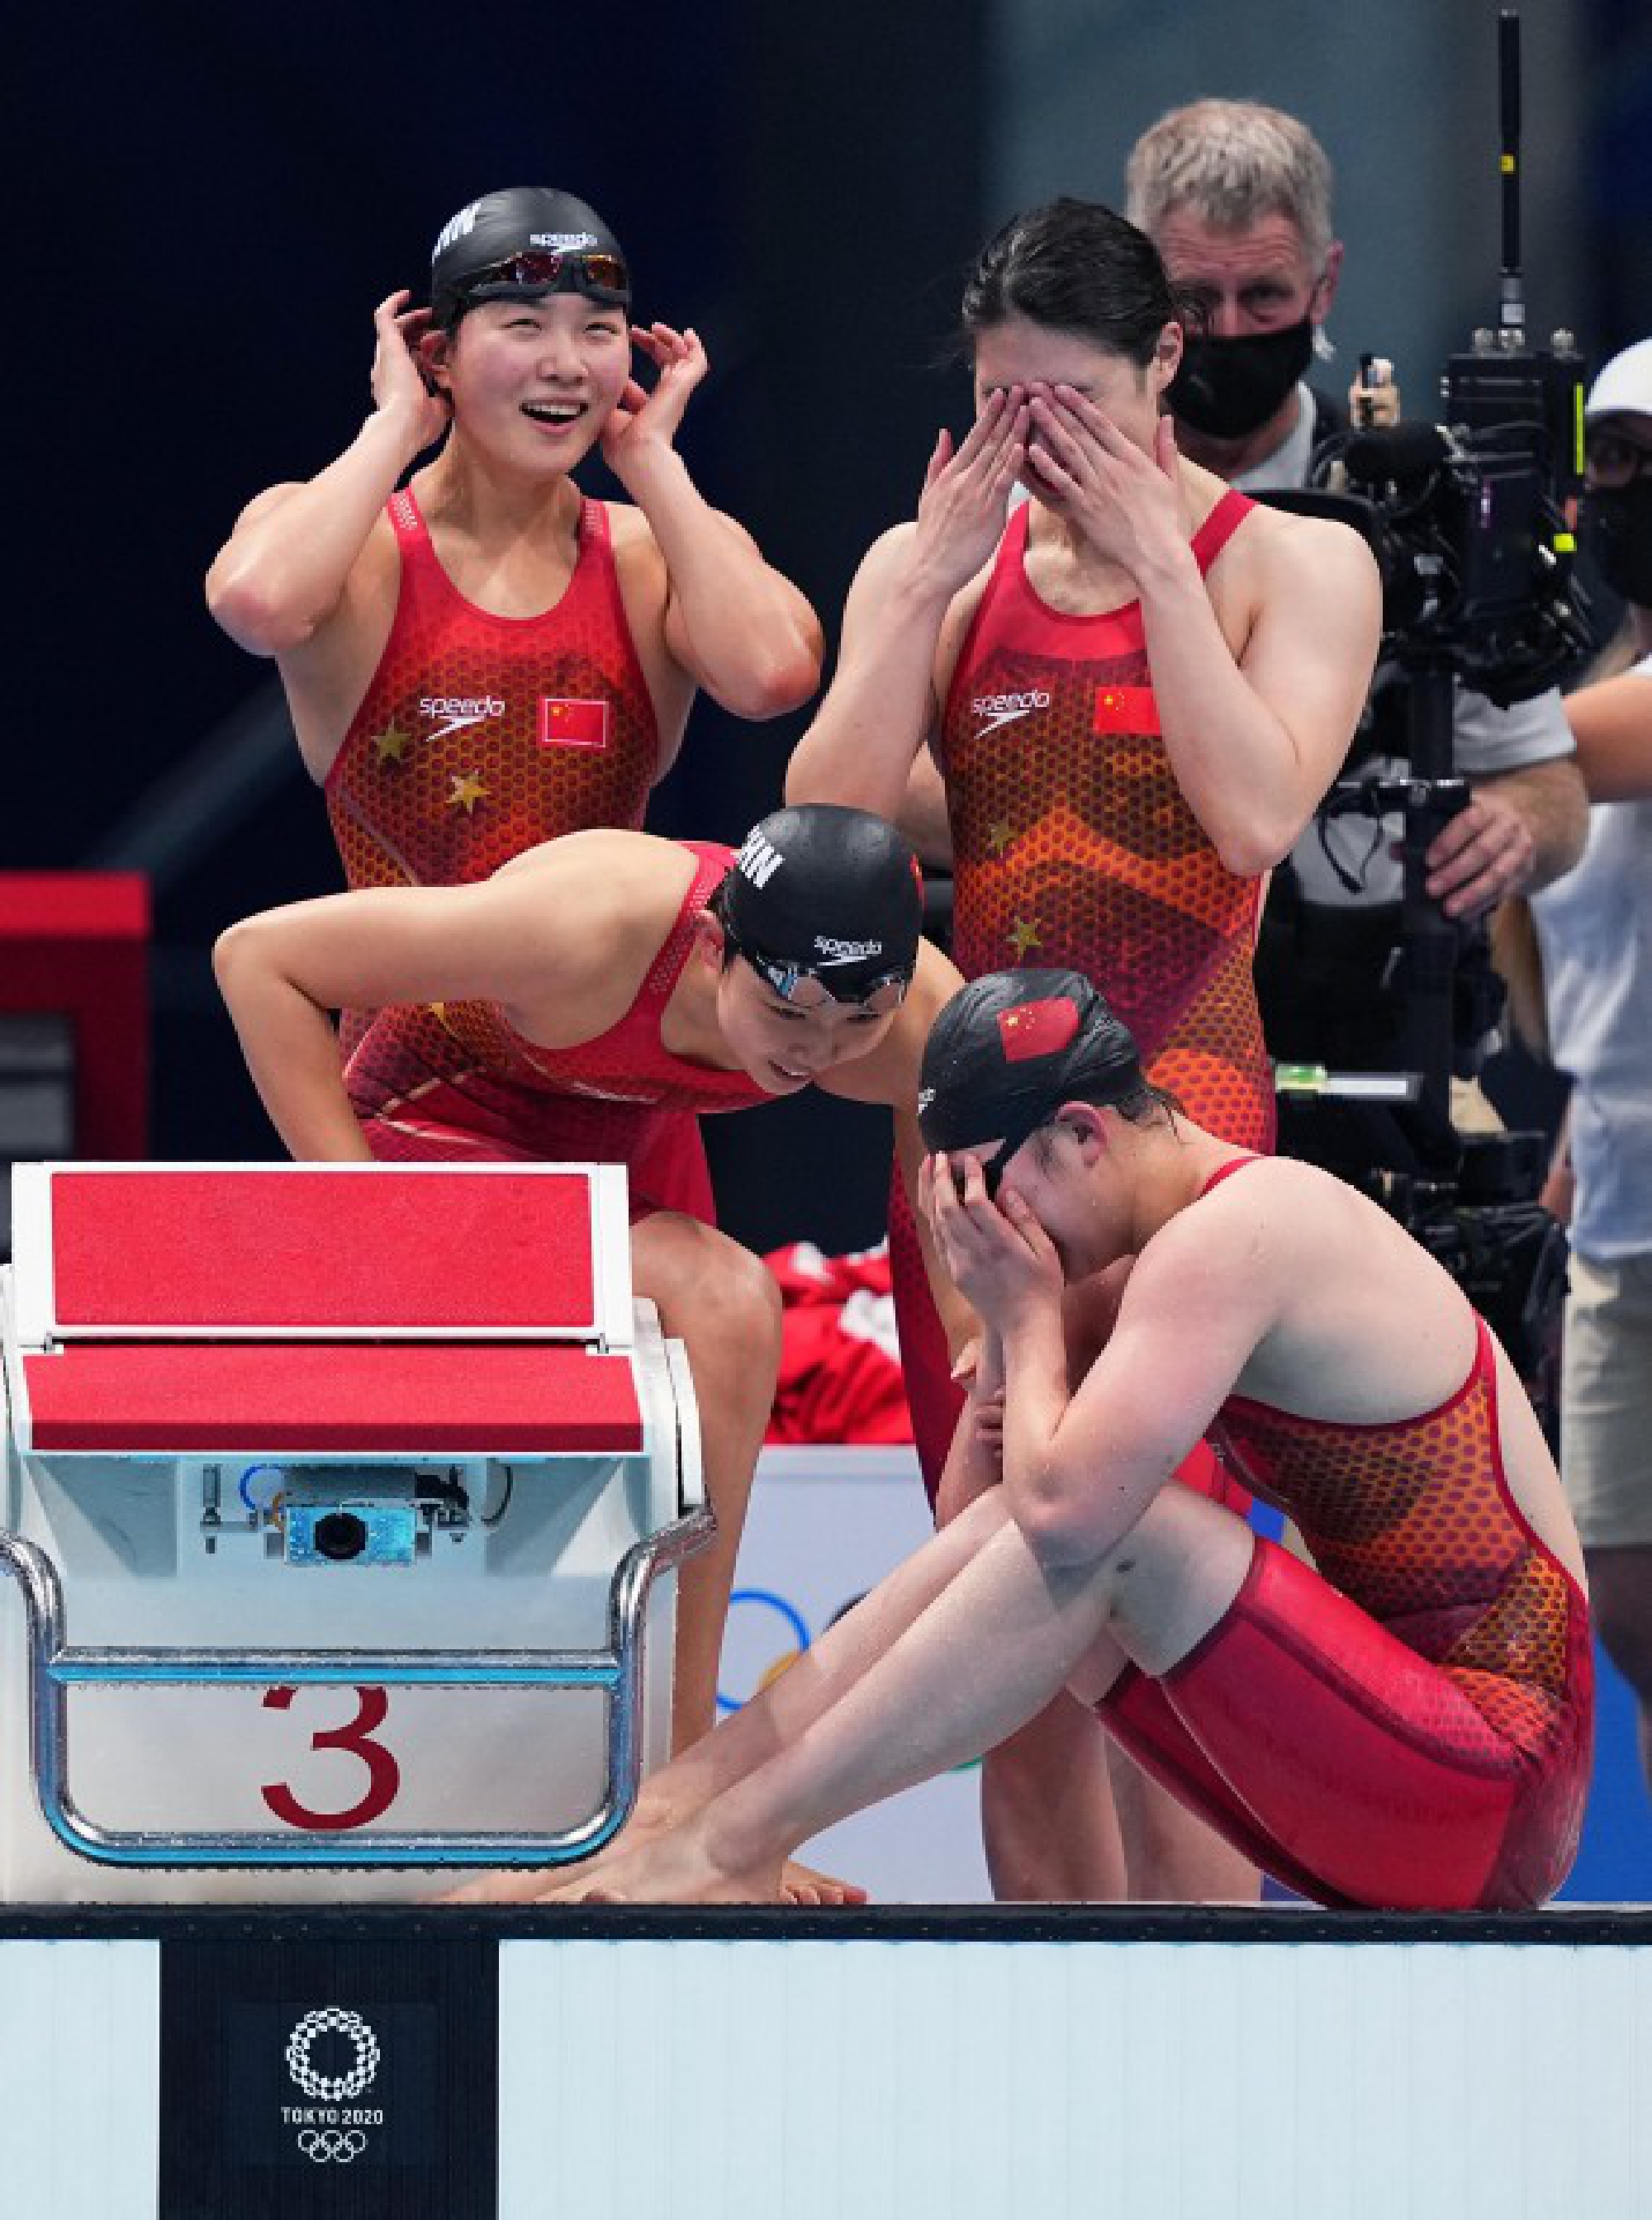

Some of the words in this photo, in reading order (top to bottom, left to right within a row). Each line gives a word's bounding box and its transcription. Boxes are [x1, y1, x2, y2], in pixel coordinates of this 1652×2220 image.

[529, 231, 598, 248] speedo
[420, 695, 505, 719] speedo
[971, 690, 1050, 716] speedo
[814, 935, 882, 955] speedo
[261, 1686, 401, 1832] 3
[281, 2107, 339, 2124] TOKYO
[342, 2109, 383, 2124] 2020
